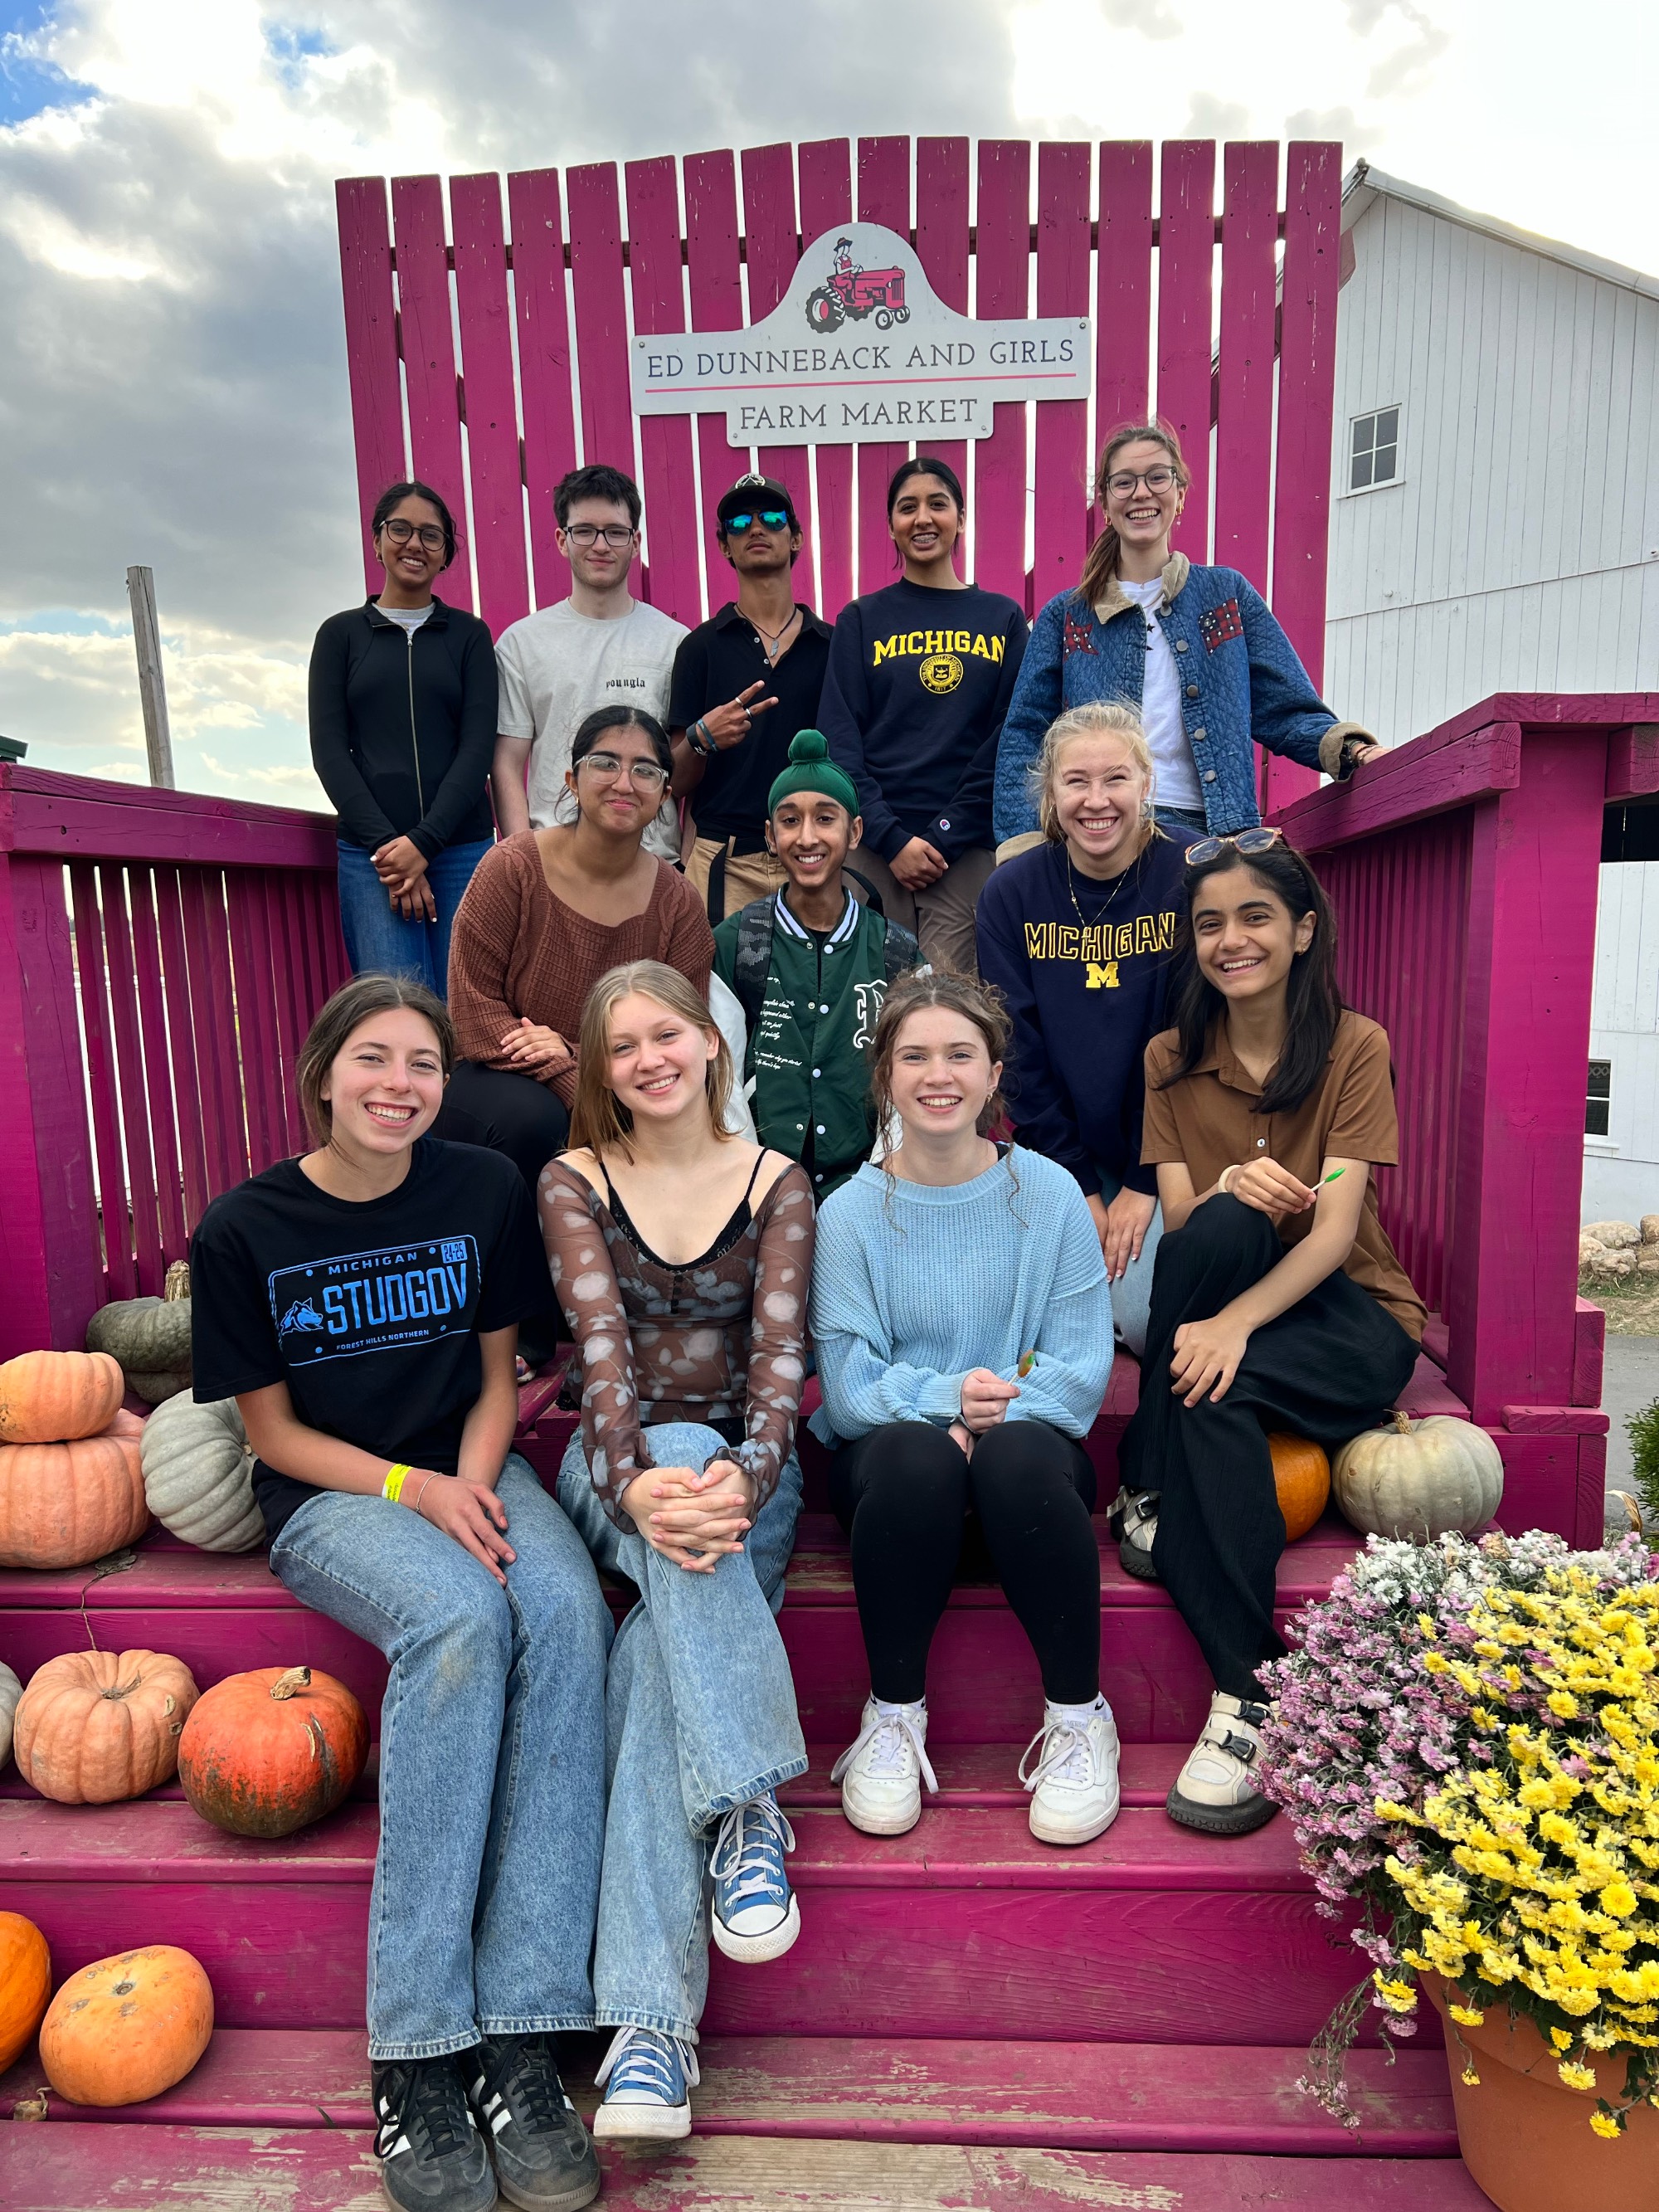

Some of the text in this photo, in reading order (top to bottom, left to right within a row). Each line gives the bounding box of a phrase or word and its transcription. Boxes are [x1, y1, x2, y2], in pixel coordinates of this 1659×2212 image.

[647, 339, 1075, 378] ED DUNNEBACK AND GIRLS
[740, 398, 979, 431] FARM MARKET
[873, 630, 1006, 667] MICHIGAN
[606, 677, 646, 690] youngla
[1024, 912, 1175, 962] MICHIGAN
[1085, 961, 1120, 989] M
[328, 1251, 417, 1275] MICHIGAN
[443, 1242, 465, 1262] 24-25
[322, 1263, 467, 1335] STUDGOV
[336, 1328, 430, 1350] FOREST HILLS NORTHERN
